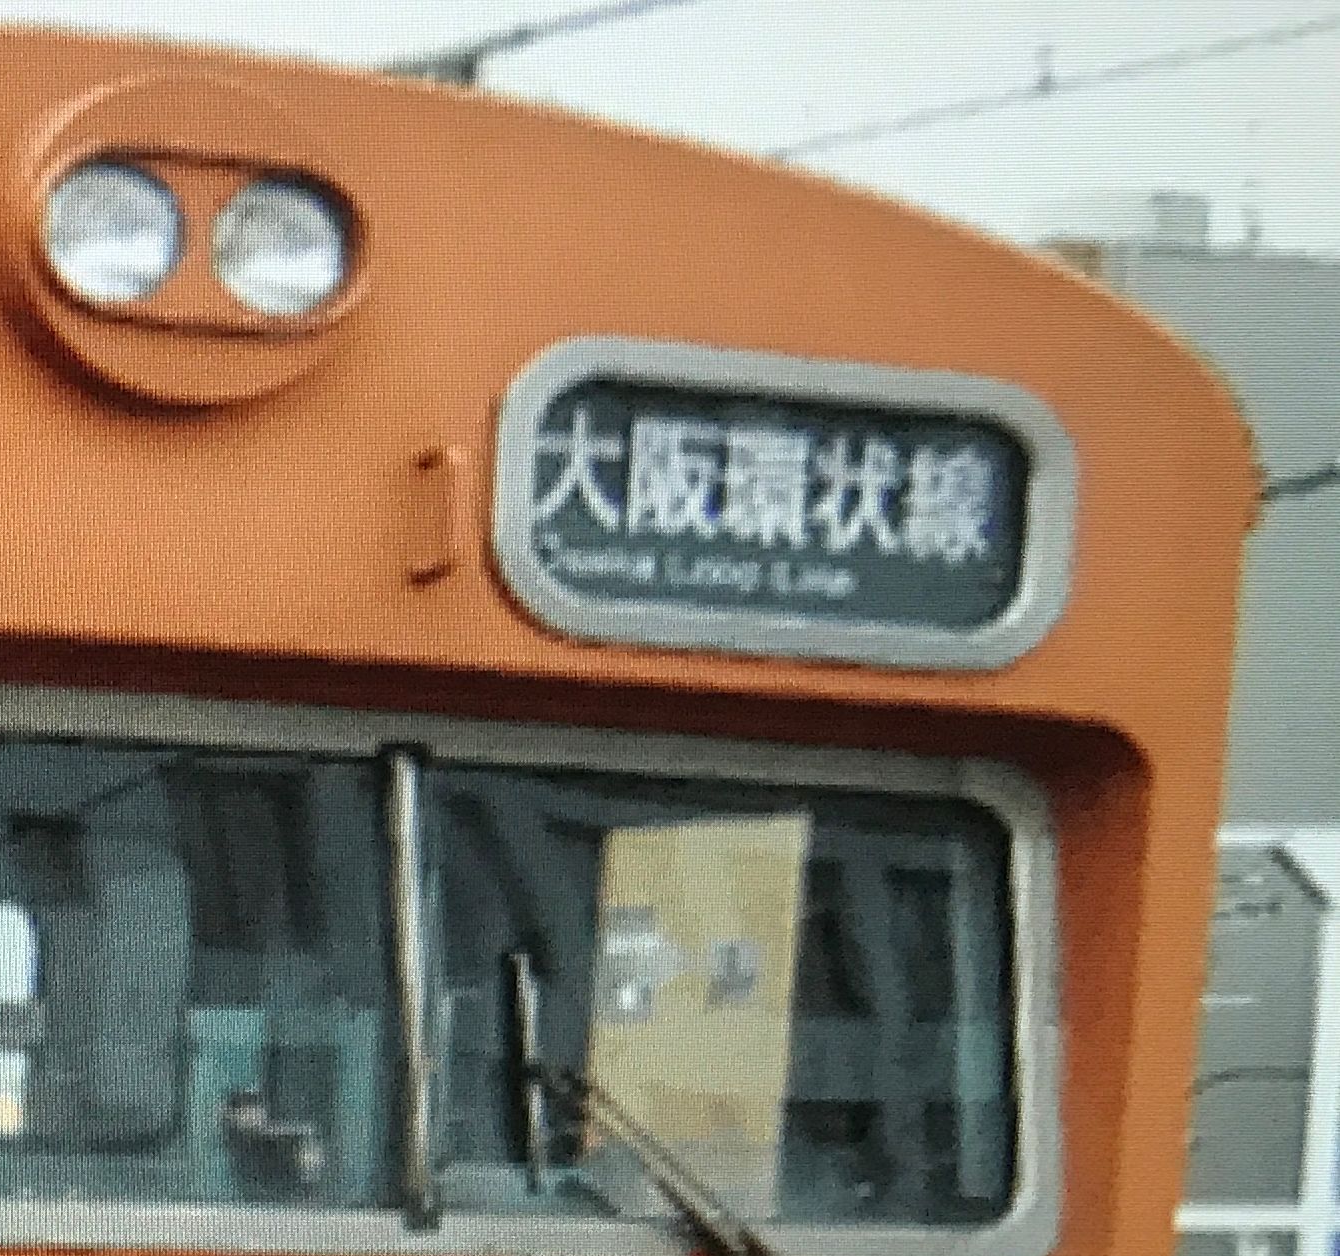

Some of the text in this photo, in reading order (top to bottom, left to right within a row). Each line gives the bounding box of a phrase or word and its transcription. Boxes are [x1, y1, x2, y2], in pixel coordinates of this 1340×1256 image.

[535, 408, 995, 562] 大阪環状線
